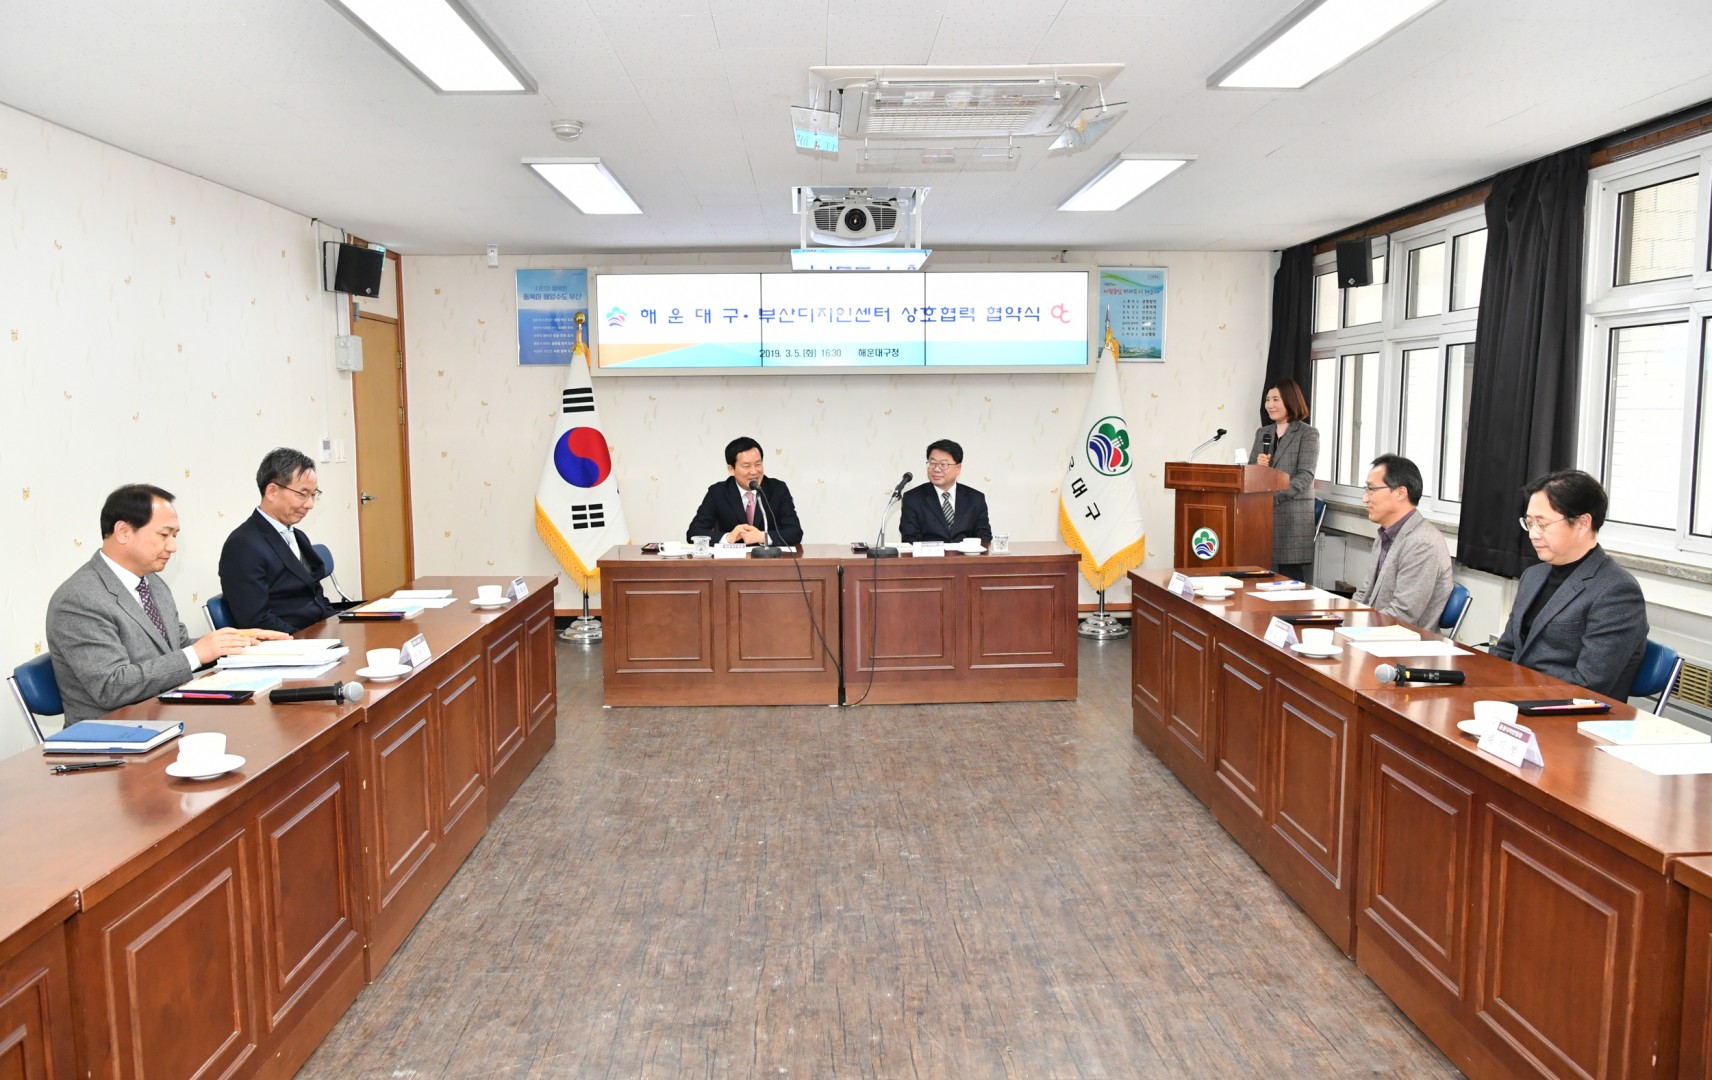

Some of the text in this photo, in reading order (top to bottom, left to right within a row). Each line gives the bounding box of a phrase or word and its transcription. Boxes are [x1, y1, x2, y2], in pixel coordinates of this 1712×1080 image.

[901, 305, 975, 324] 상호협력
[986, 305, 1040, 324] 협약식
[857, 347, 900, 359] 해운대구청
